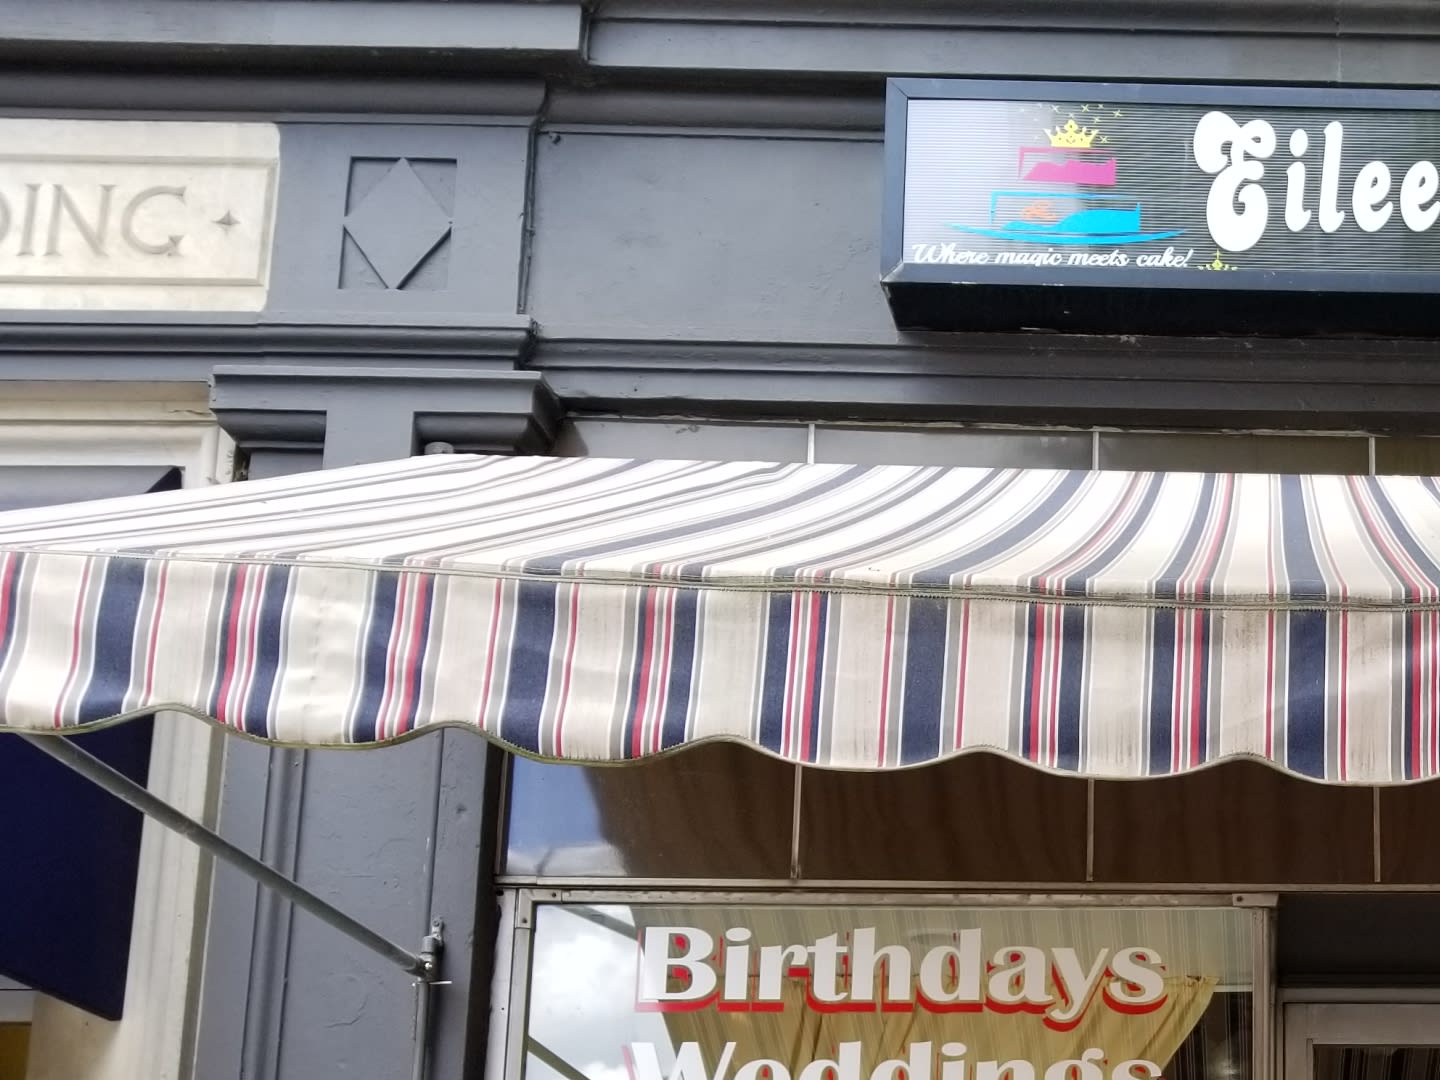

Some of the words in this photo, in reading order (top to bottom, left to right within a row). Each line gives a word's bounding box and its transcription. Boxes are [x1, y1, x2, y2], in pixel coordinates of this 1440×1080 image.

[0, 183, 187, 258] ING
[912, 243, 988, 265] Where
[992, 248, 1062, 266] magic
[1067, 248, 1129, 267] meets
[1136, 247, 1194, 268] cake!
[636, 926, 1168, 1030] Birthdays
